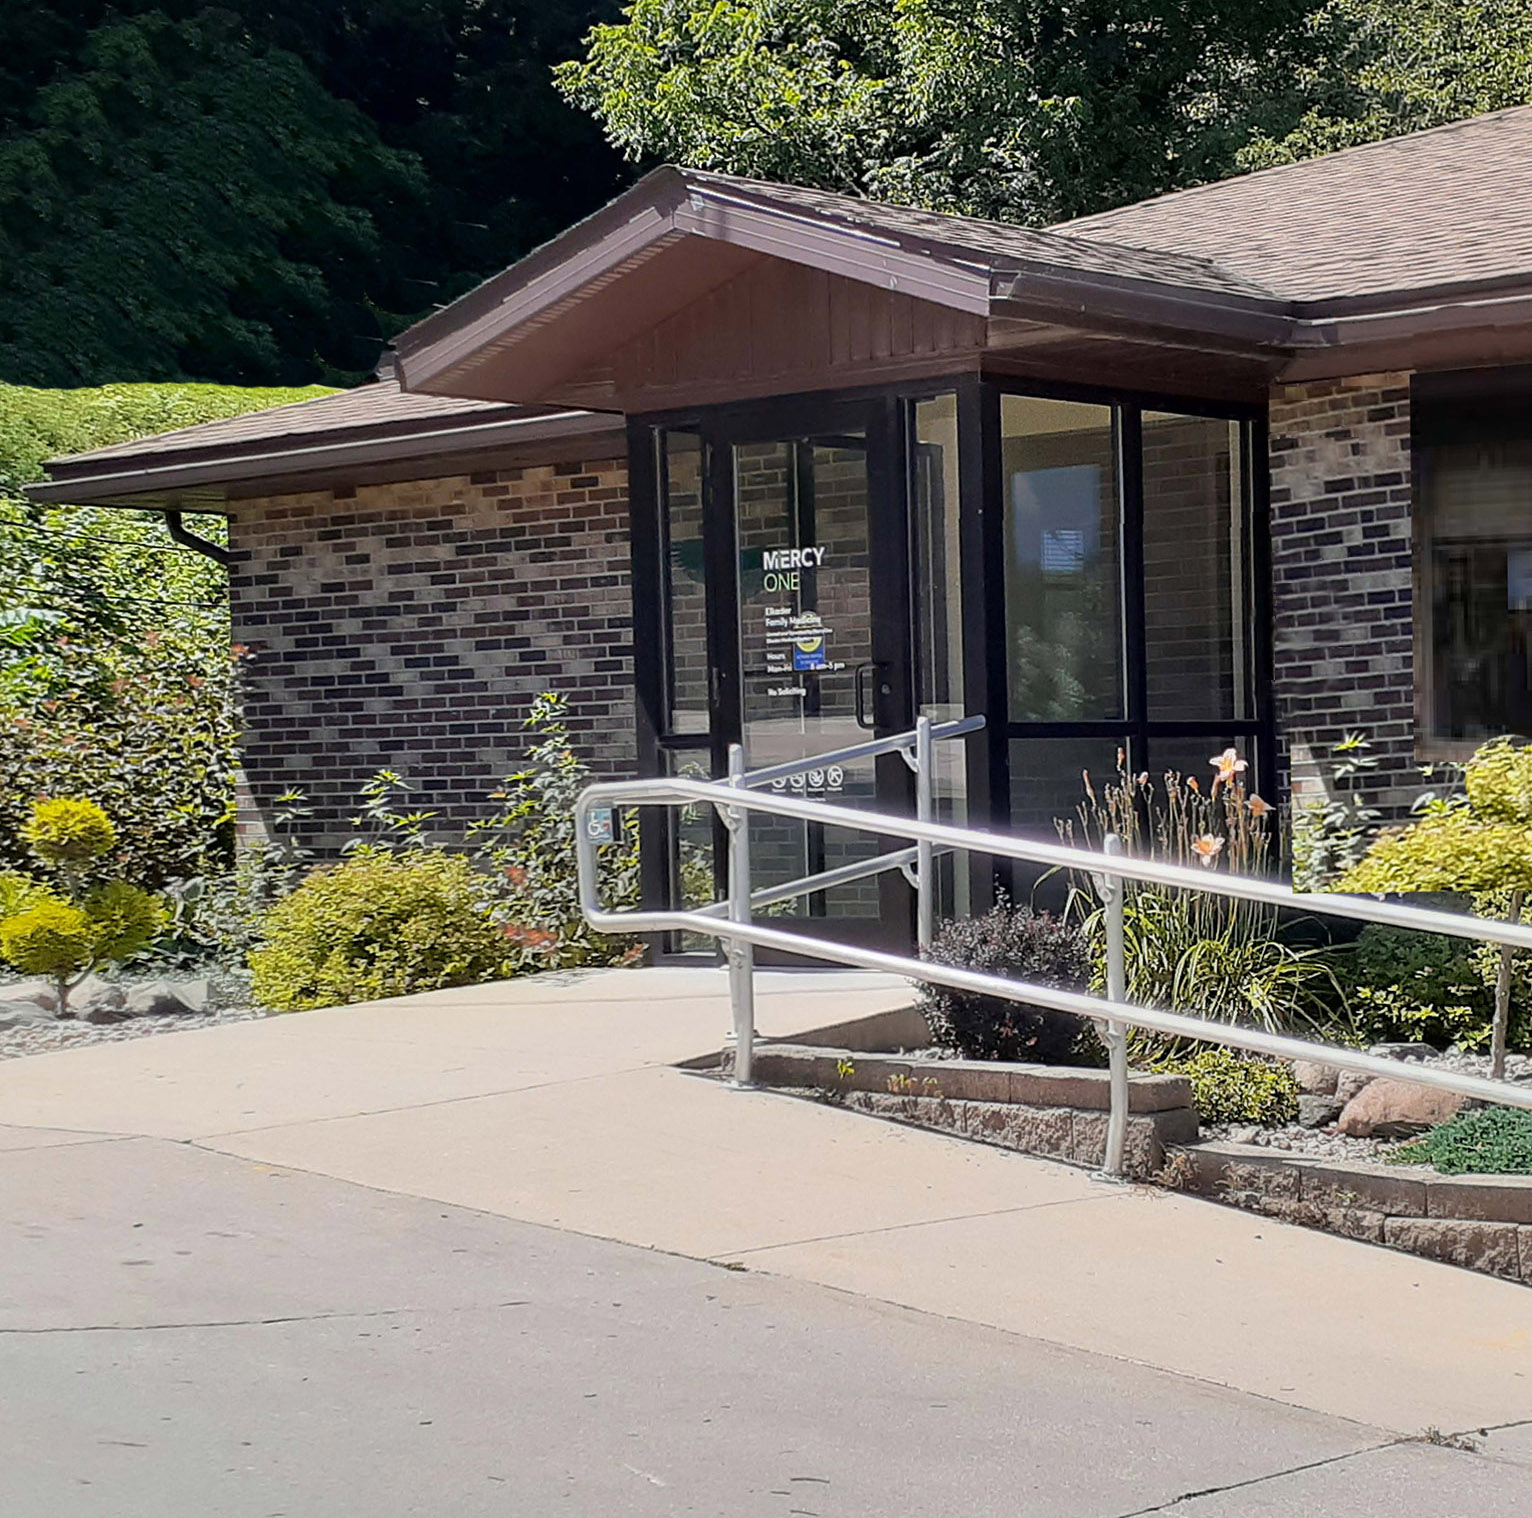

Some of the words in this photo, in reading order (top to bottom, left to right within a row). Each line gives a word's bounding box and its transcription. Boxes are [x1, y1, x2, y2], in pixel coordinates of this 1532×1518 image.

[763, 546, 825, 571] MERCY
[764, 572, 799, 592] ONE
[765, 617, 788, 628] Family
